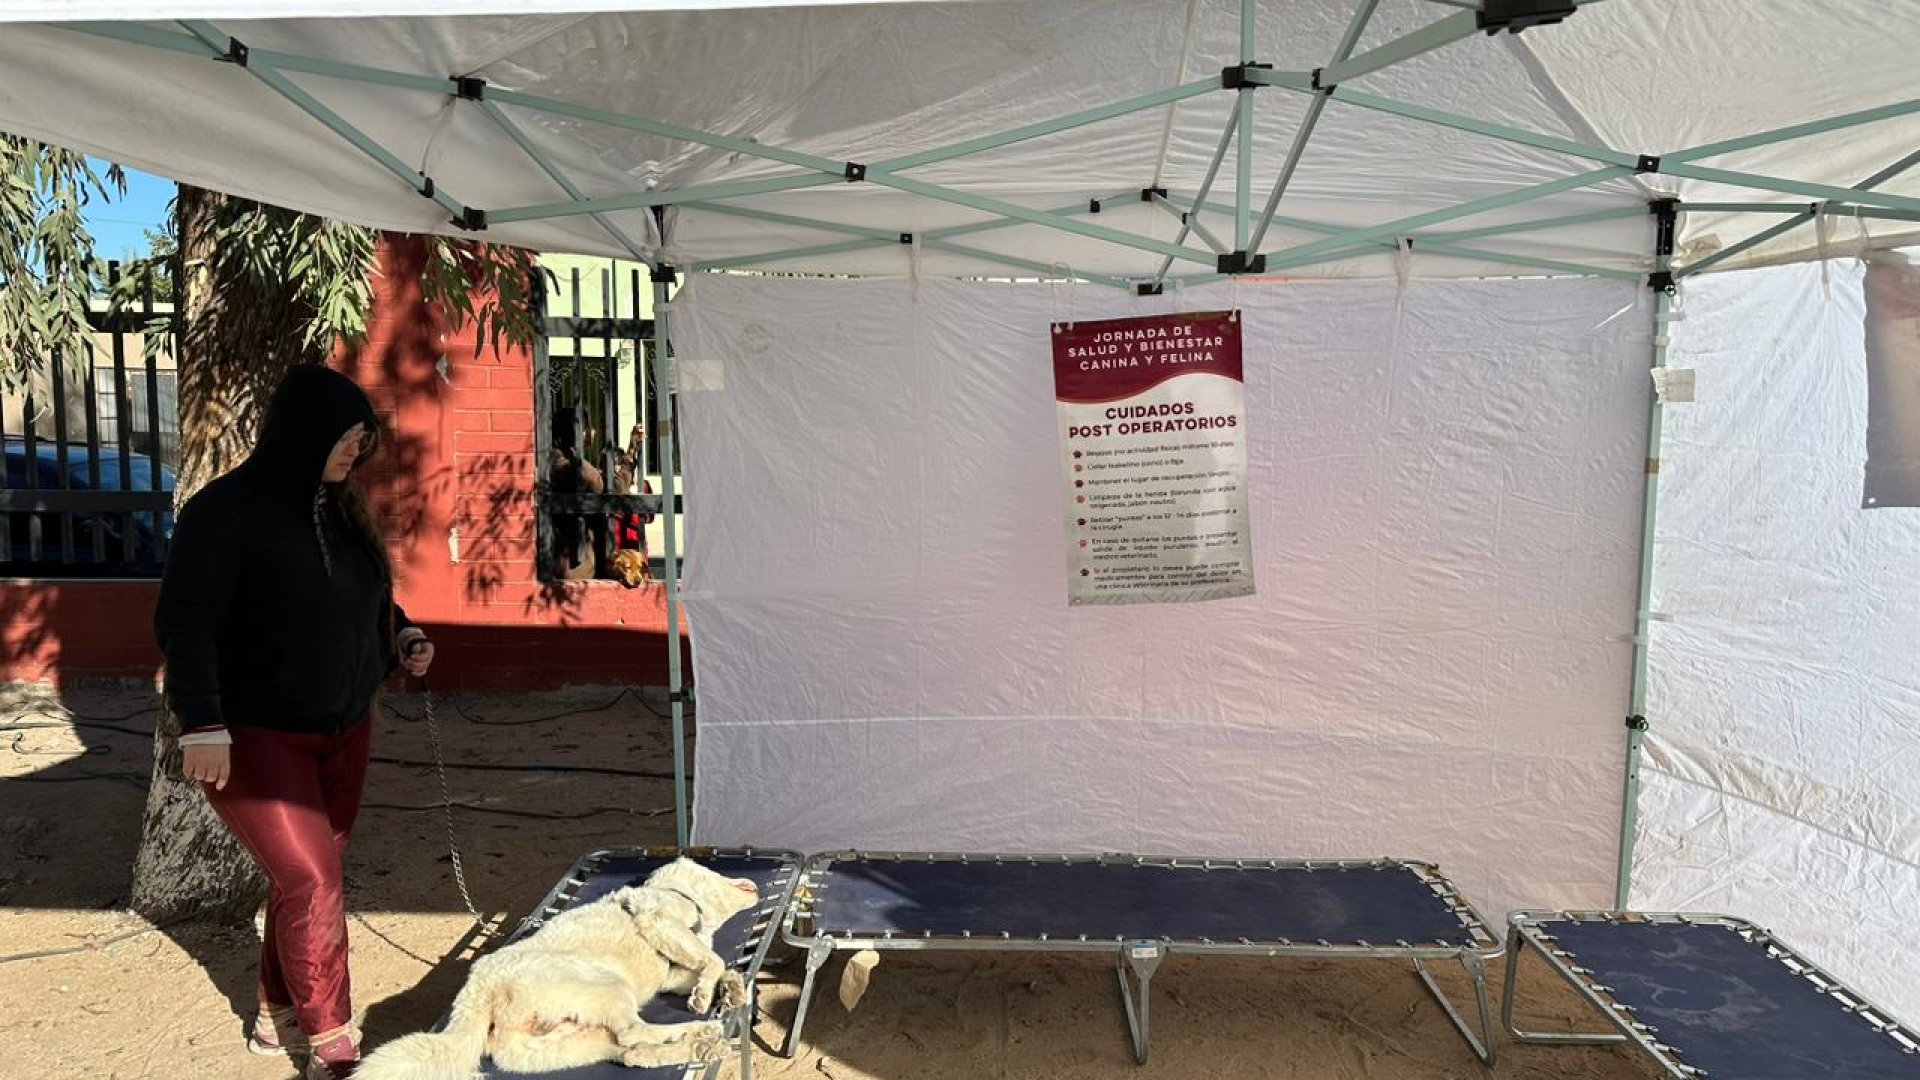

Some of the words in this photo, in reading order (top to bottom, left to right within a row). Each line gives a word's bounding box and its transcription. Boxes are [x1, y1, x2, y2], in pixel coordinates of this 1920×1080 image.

[1093, 327, 1167, 343] JORNADA
[1173, 325, 1192, 336] DE
[1068, 345, 1118, 358] SALUD
[1124, 343, 1133, 353] Y
[1139, 336, 1224, 352] BIENESTAR
[1079, 358, 1139, 371] CANINA
[1145, 355, 1154, 365] Y
[1160, 351, 1214, 364] FELINA
[1105, 402, 1195, 420] CUIDADOS
[1069, 424, 1113, 438] POST
[1118, 415, 1237, 436] OPERATORIOS
